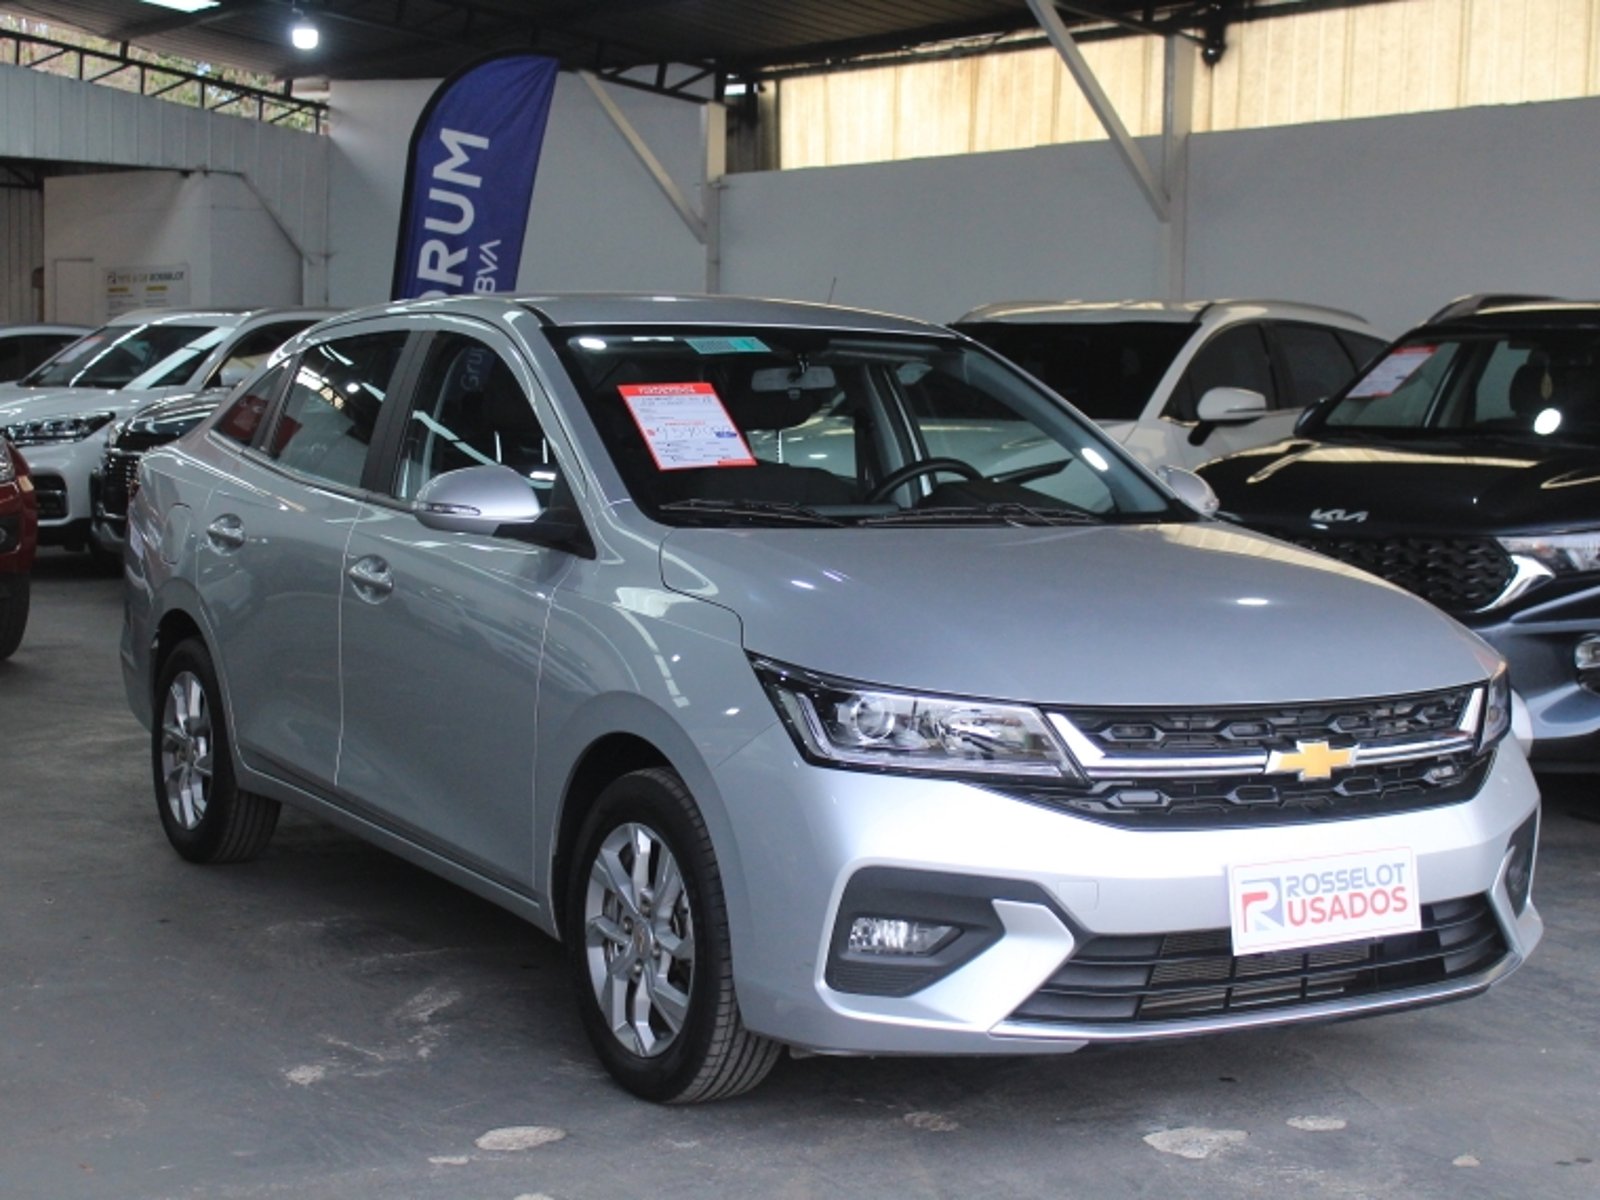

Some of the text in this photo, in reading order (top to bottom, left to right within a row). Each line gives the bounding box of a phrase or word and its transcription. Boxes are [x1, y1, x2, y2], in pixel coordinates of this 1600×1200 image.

[417, 128, 490, 300] RUM
[1310, 509, 1368, 522] KIA
[1286, 863, 1405, 897] ROSSELOT
[1287, 886, 1408, 927] USADOS
